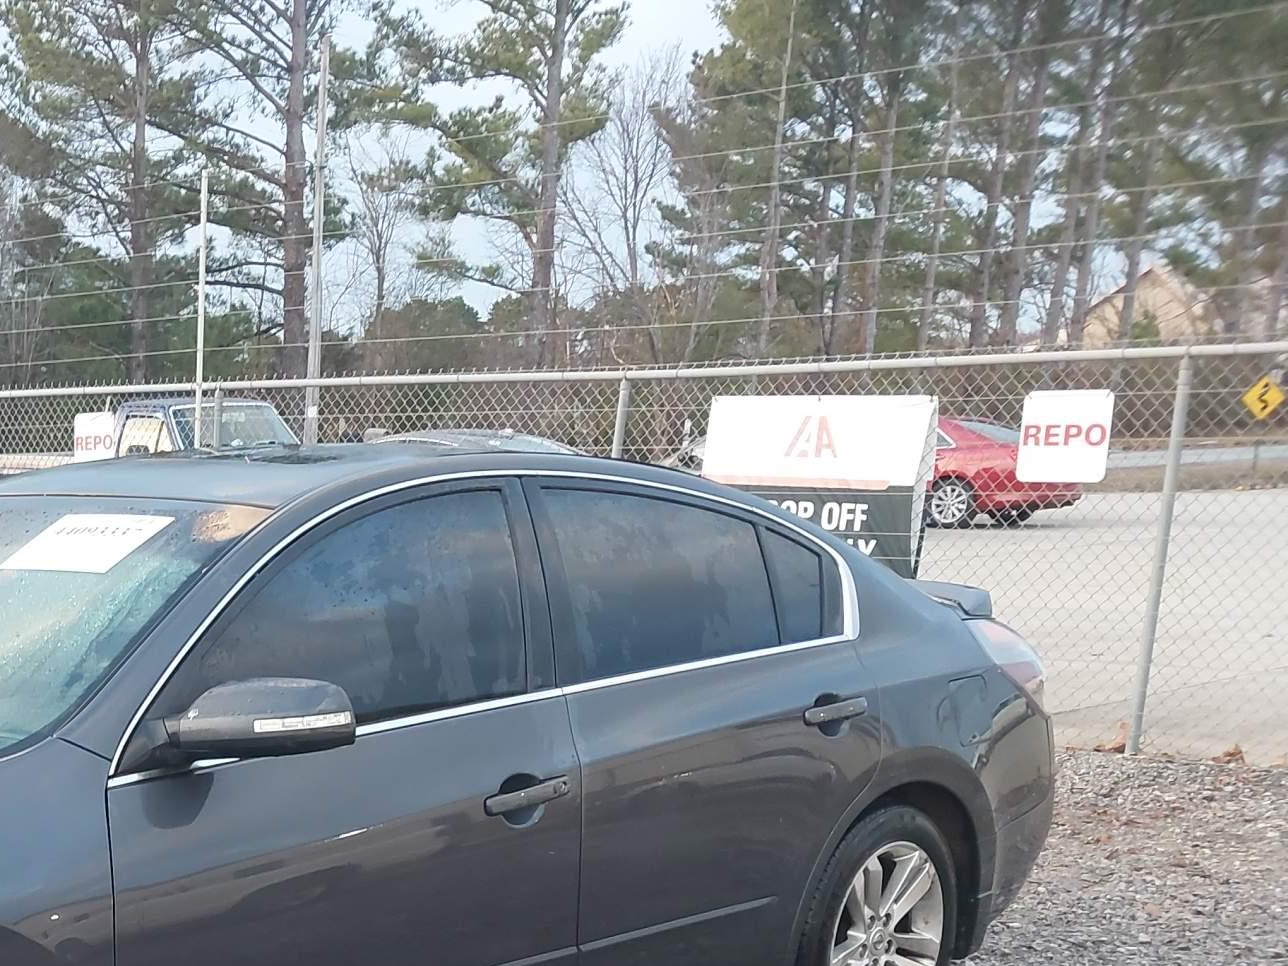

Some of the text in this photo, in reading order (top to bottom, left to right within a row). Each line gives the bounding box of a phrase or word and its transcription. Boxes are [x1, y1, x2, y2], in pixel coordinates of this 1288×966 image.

[75, 434, 113, 451] REPO
[1022, 424, 1107, 447] REPO
[821, 501, 869, 532] OFF
